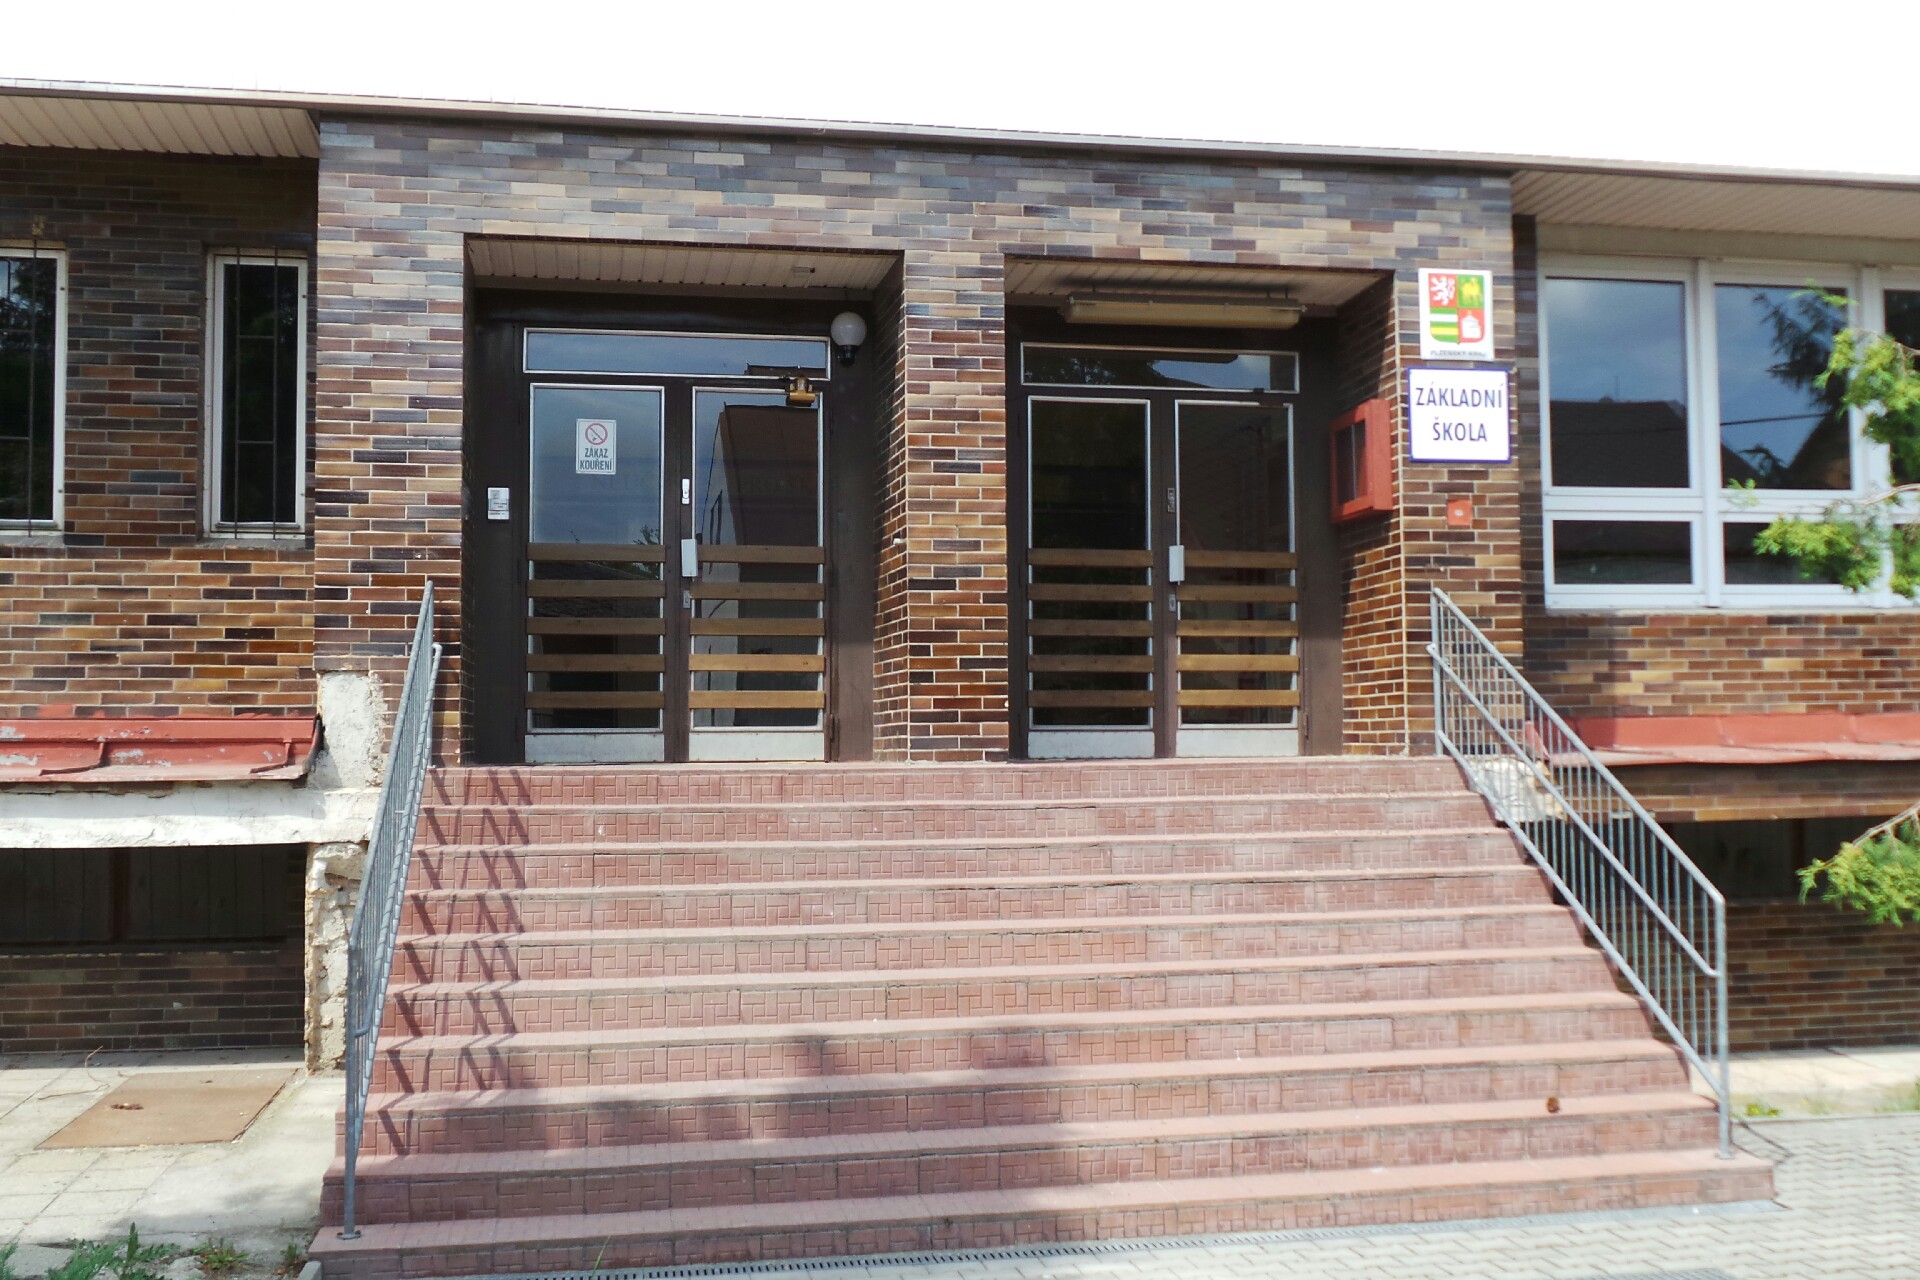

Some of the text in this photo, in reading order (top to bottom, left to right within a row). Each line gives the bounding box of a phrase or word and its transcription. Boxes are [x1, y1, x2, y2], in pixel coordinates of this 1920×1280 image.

[1415, 381, 1504, 408] ZÁKLADNÍ
[1432, 416, 1487, 442] ŠKOLA
[584, 446, 608, 458] ZÁKAZ
[580, 458, 612, 470] KOUŘENÍ
